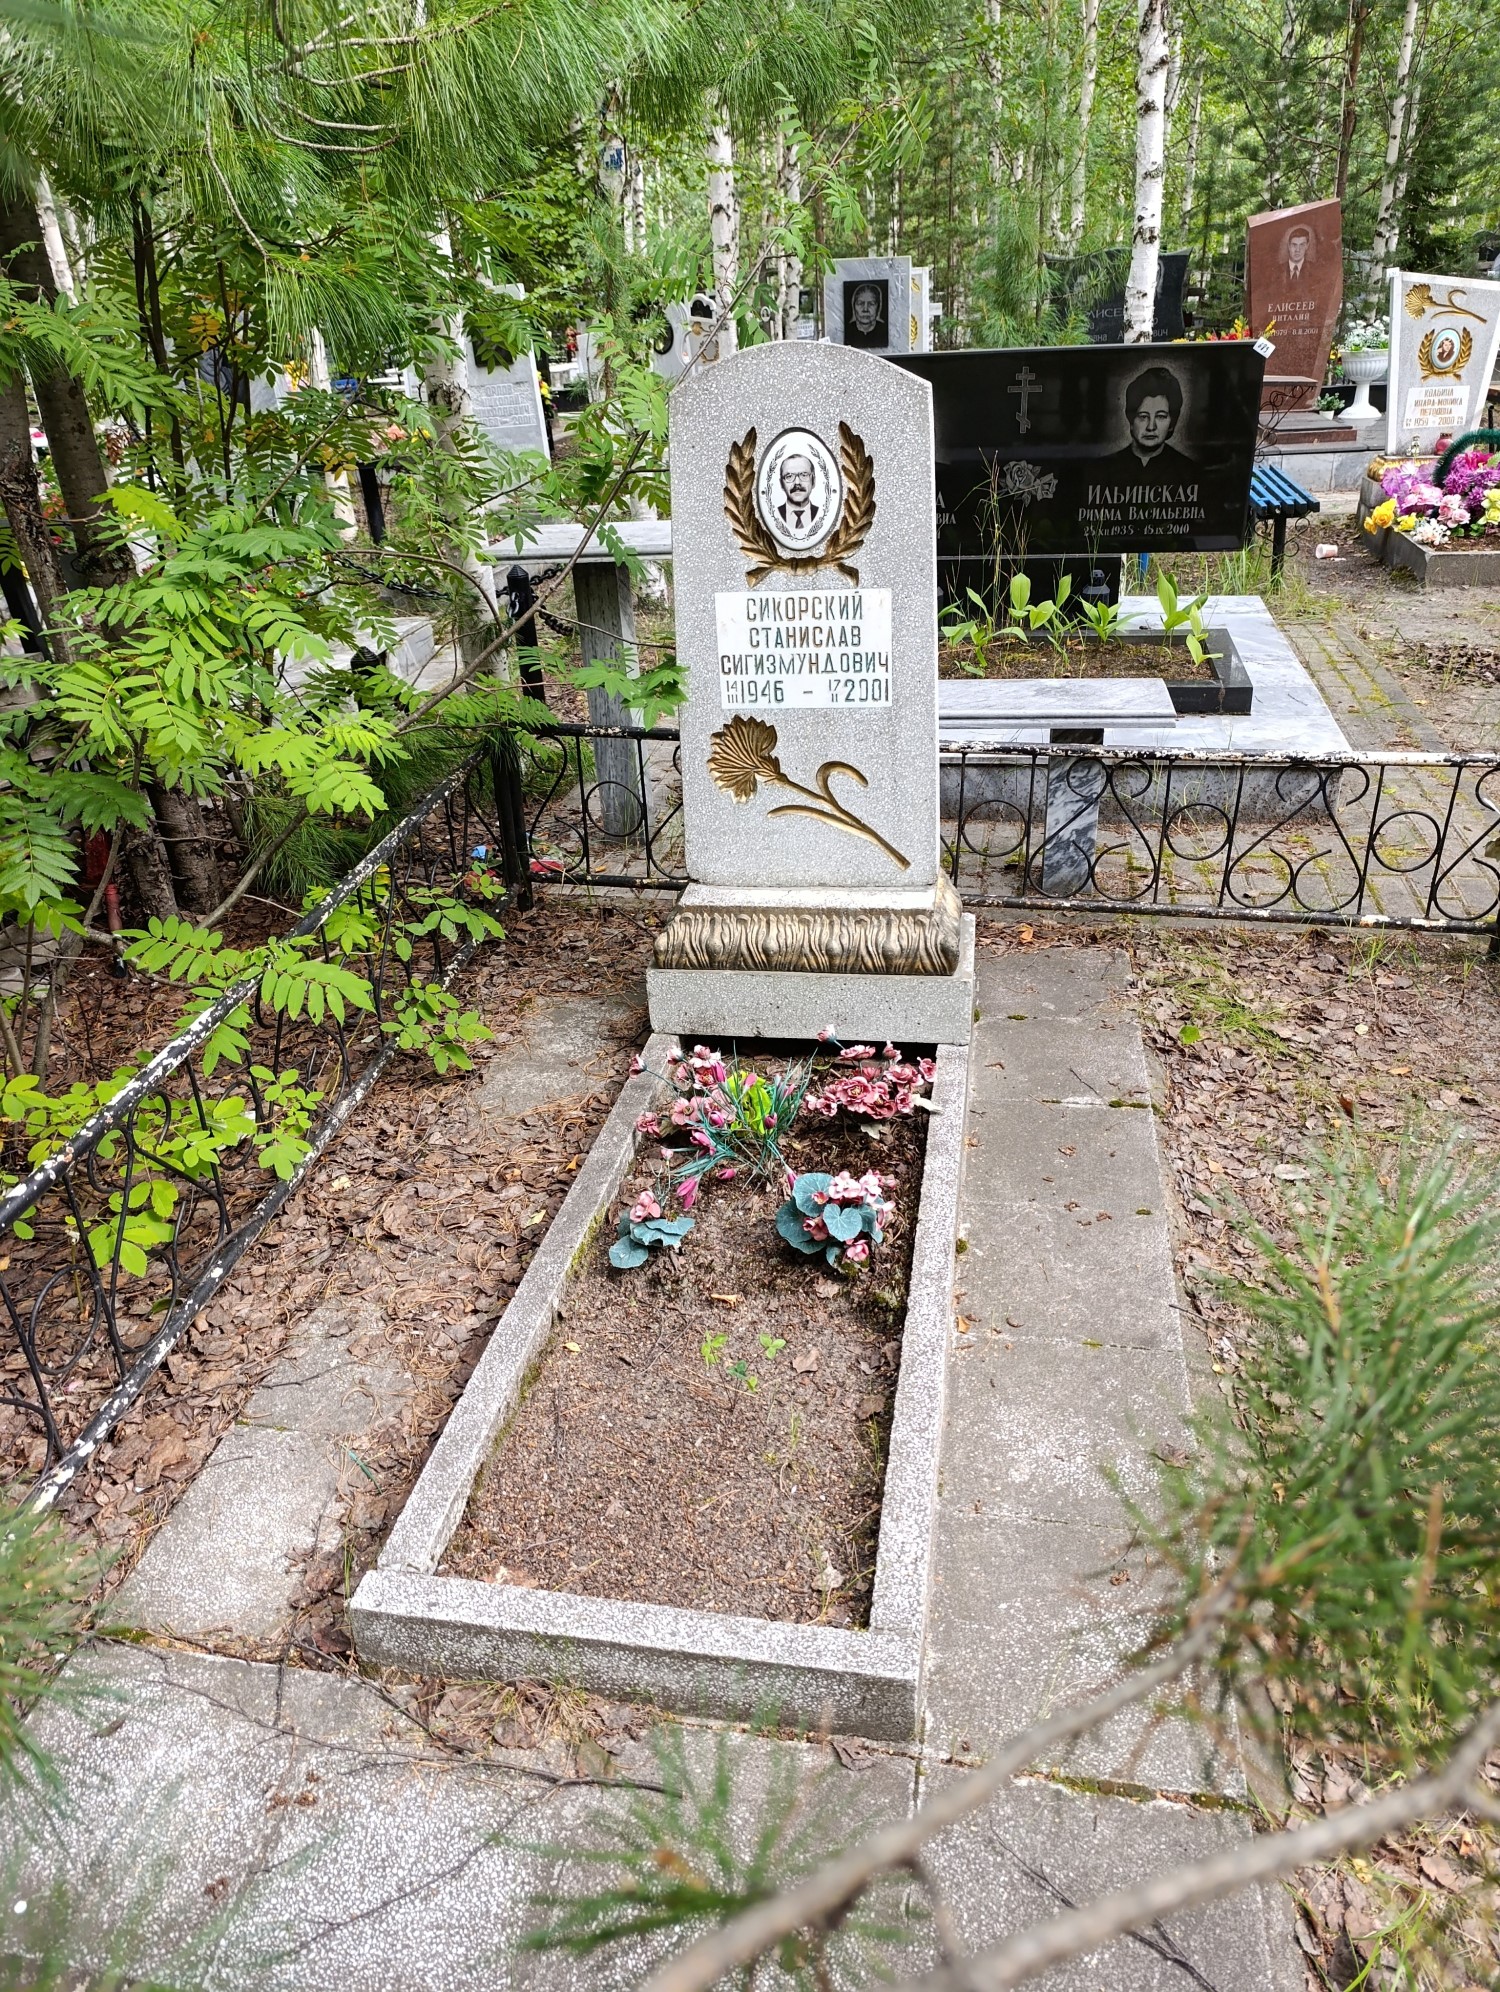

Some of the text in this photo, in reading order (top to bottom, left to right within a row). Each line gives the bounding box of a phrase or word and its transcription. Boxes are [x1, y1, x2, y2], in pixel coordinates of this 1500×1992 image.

[1268, 301, 1315, 313] ЕЛИСЕЕВ
[1088, 484, 1199, 505] ИЛЬИНСКАЯ
[1078, 506, 1206, 522] РИММА ВАСИЛЬЕВНА
[746, 591, 863, 621] СИКОРСКИЙ
[749, 625, 862, 648] СТАНИСЛАВ
[720, 651, 889, 675] СИГИЗМУНДОВИЧ
[741, 680, 785, 704] 1946
[844, 678, 889, 702] 2001
